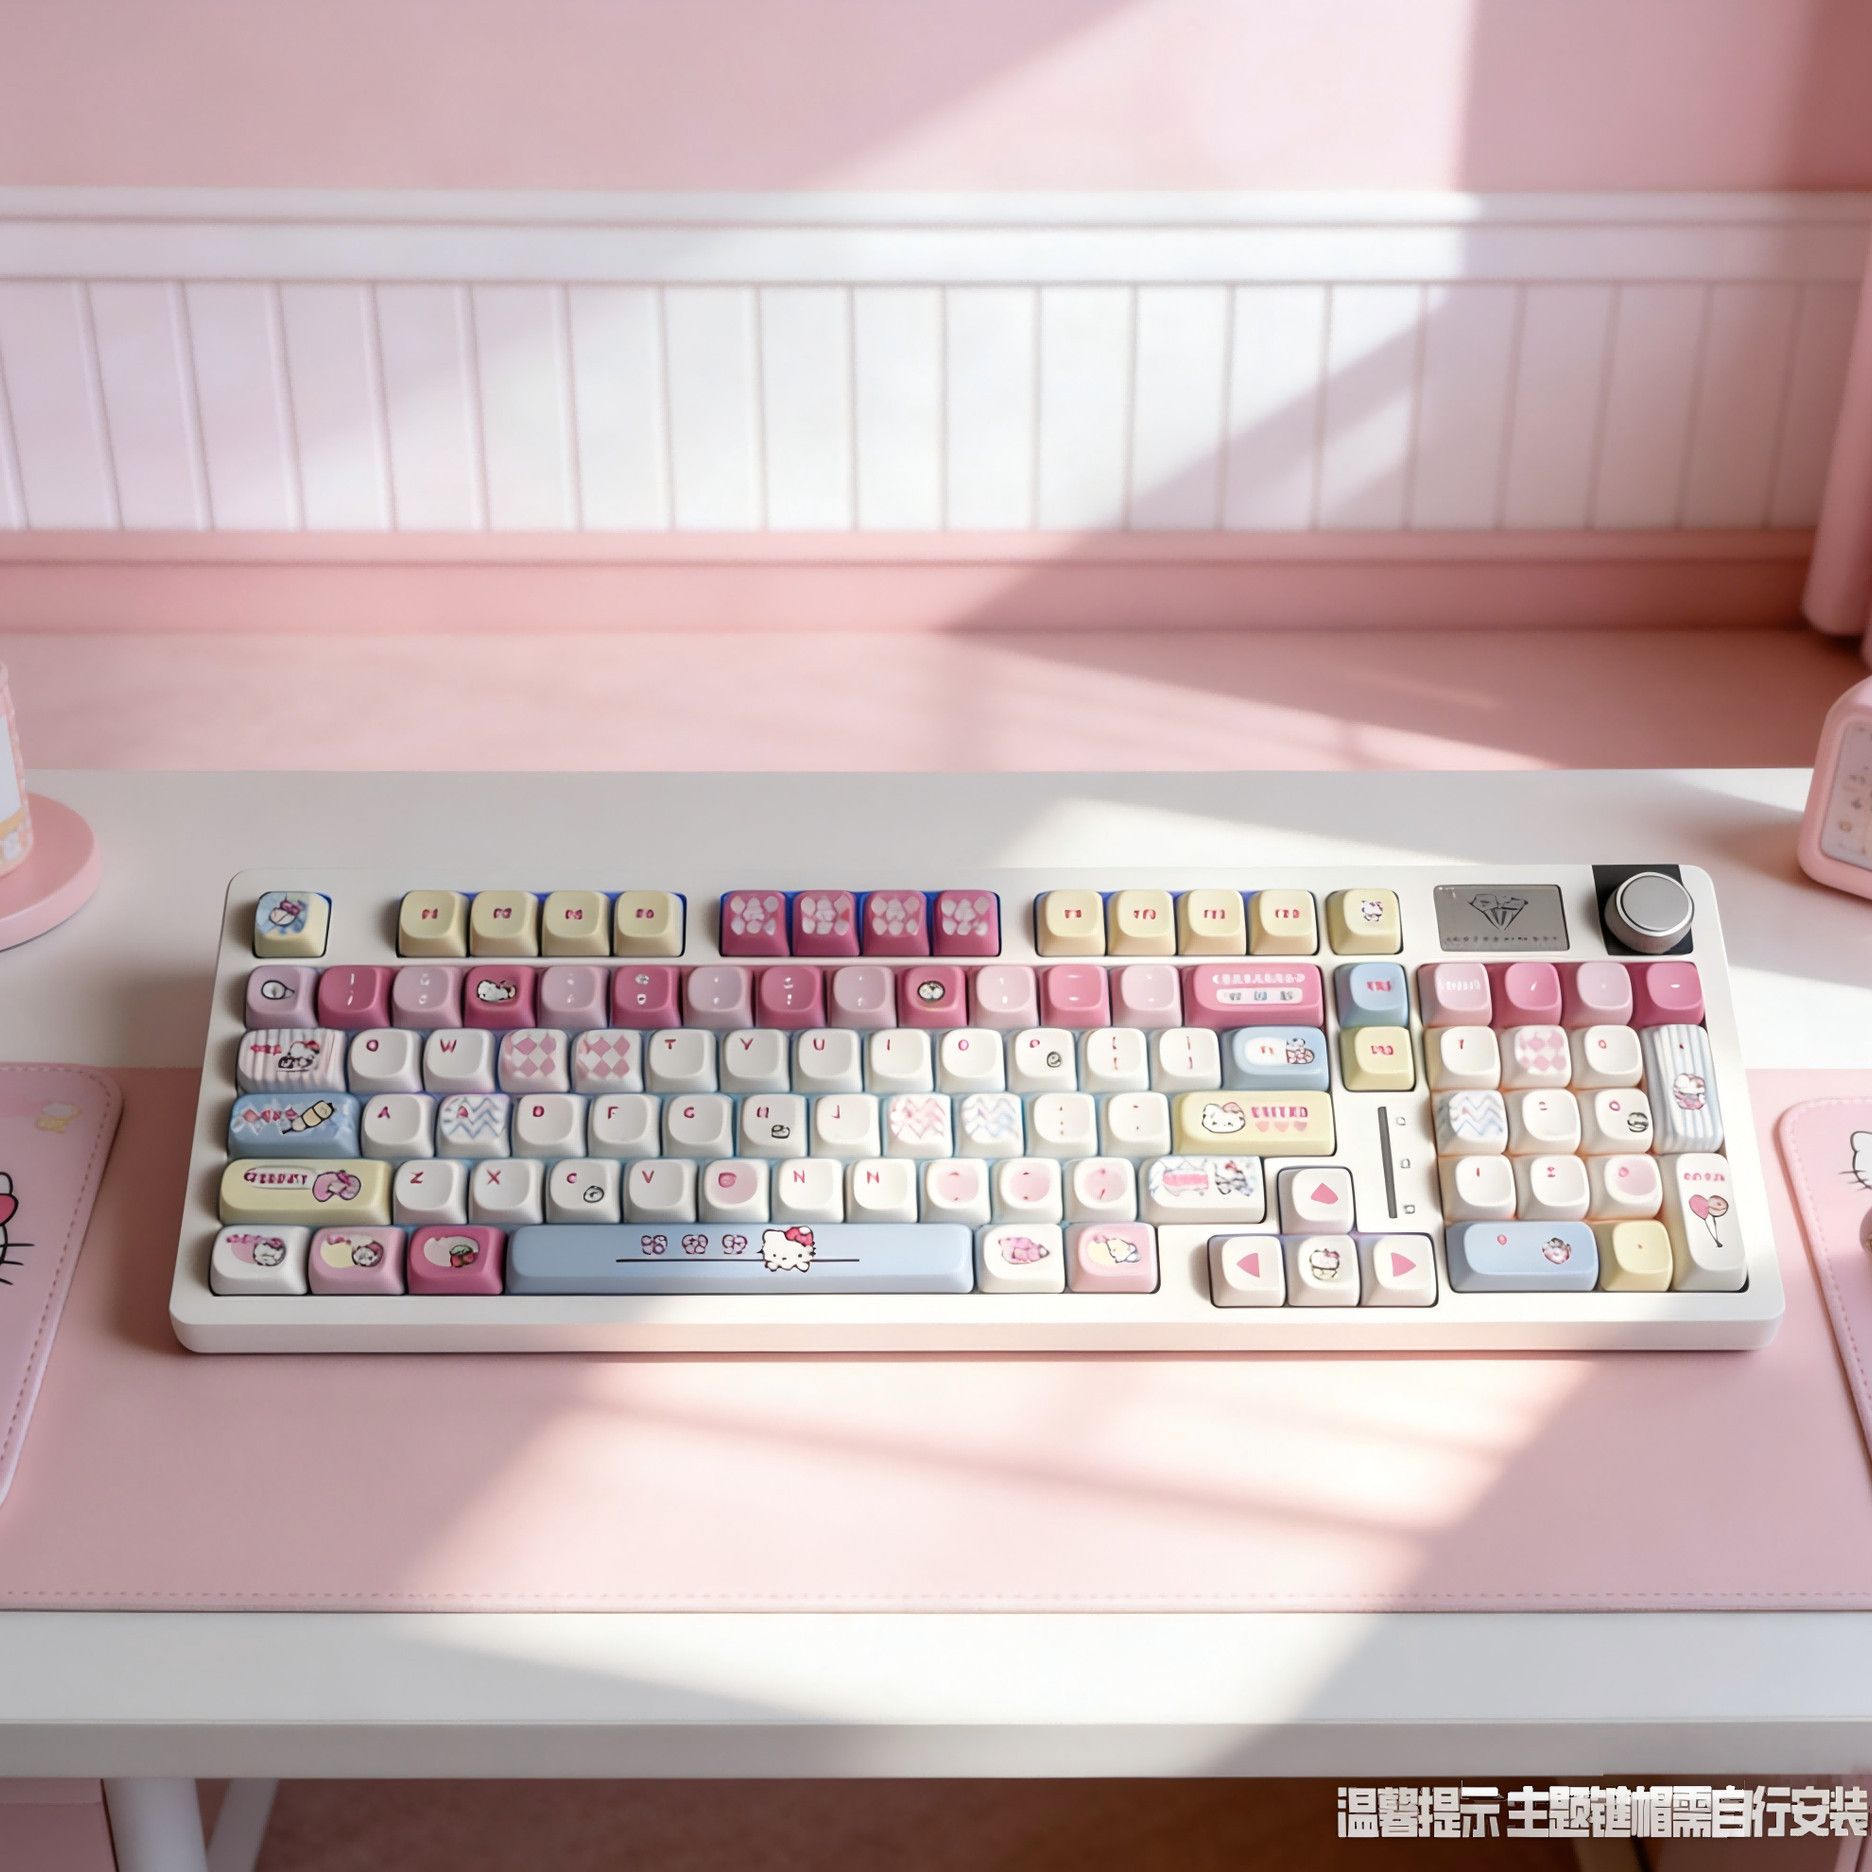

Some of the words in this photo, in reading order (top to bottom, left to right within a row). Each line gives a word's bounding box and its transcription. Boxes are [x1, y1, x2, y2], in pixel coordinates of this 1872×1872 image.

[439, 1039, 457, 1054] W
[663, 1038, 678, 1051] T
[811, 1039, 827, 1053] U
[606, 1105, 618, 1119] F
[409, 1169, 425, 1186] Z
[487, 1168, 501, 1185] X
[566, 1170, 578, 1185] C
[640, 1167, 654, 1185] V
[793, 1169, 807, 1185] N
